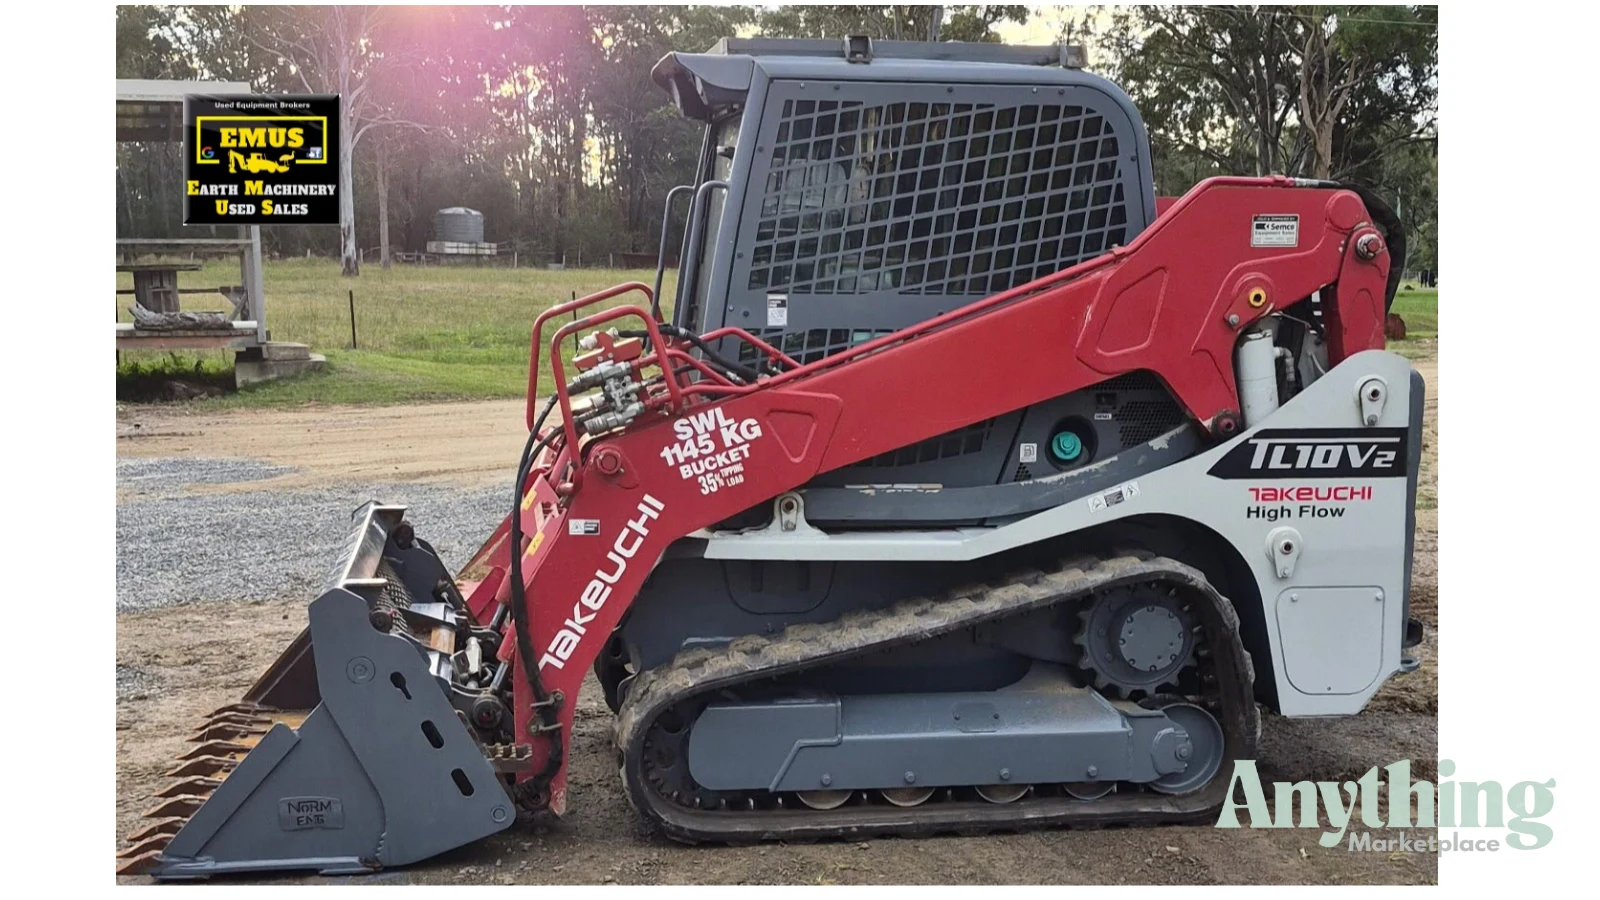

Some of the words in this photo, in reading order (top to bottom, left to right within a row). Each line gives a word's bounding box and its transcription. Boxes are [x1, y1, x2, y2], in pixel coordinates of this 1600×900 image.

[1270, 223, 1295, 231] Semco
[673, 406, 735, 441] SWL
[660, 432, 715, 467] 1145
[720, 418, 762, 448] KG
[1249, 437, 1400, 469] TL10V2
[679, 443, 750, 480] BUCKET
[698, 472, 725, 495] 35%
[720, 462, 744, 478] TIPPING
[726, 474, 744, 487] LOAD
[1247, 505, 1291, 521] High
[1299, 505, 1345, 518] Flow
